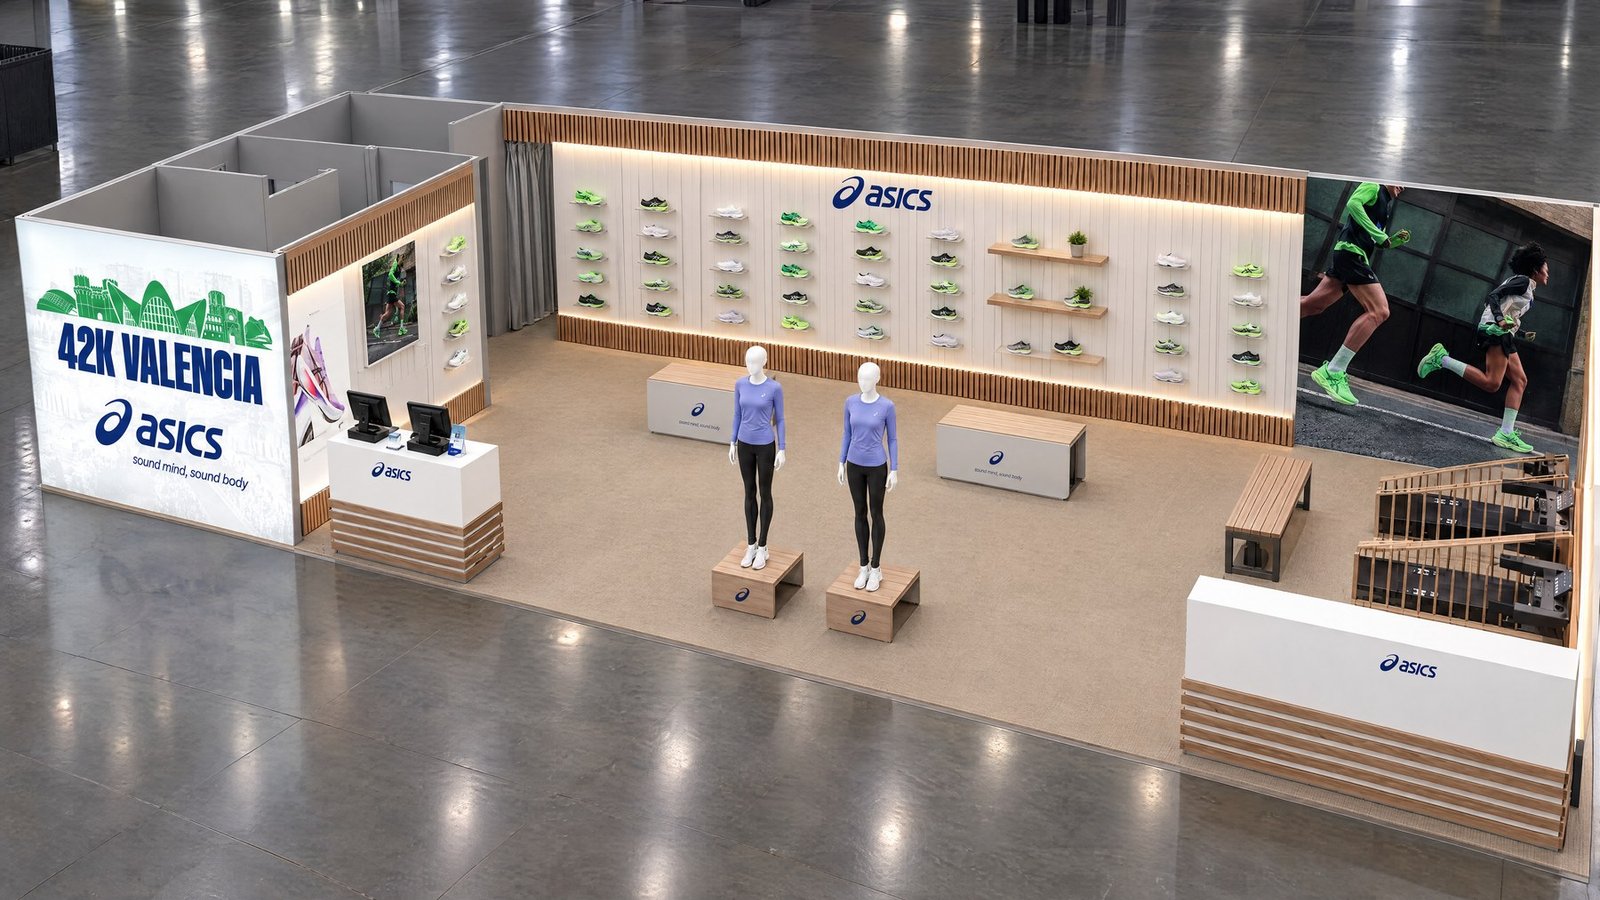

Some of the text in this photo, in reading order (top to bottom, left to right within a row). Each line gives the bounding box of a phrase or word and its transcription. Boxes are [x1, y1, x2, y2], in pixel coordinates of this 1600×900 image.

[58, 323, 263, 405] 42K VALENCIA
[133, 456, 249, 492] sound mind, sound body
